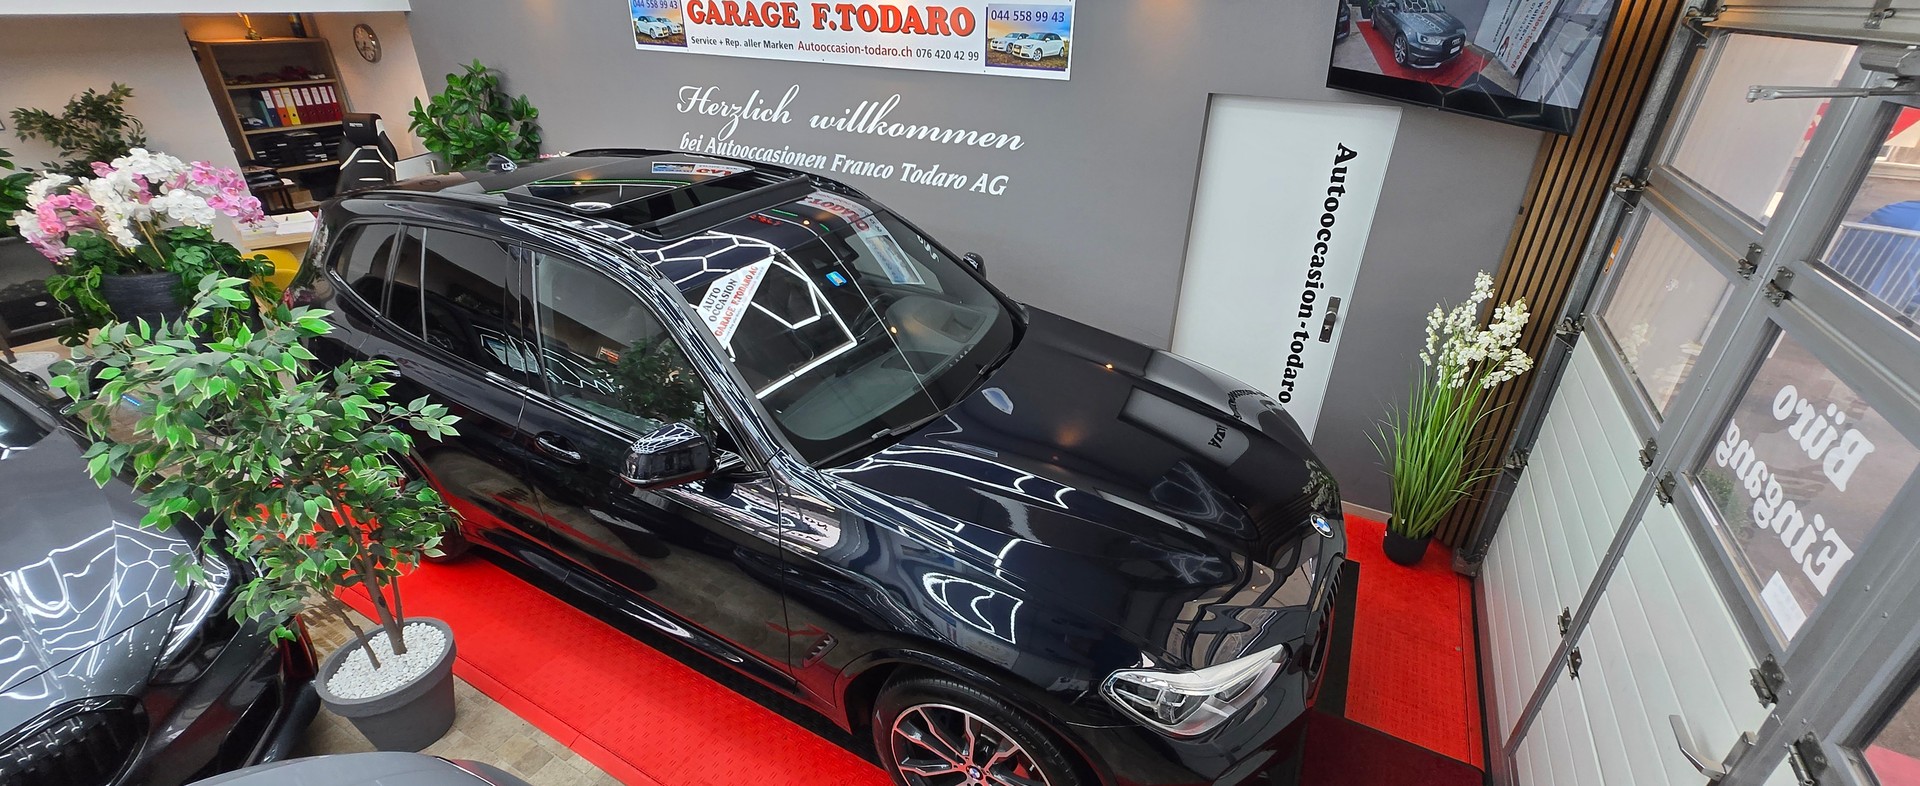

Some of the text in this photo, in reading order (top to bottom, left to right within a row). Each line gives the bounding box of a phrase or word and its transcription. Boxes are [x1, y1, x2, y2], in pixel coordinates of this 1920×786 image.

[632, 0, 678, 9] 044 558 99 43
[686, 0, 976, 36] GARAGE F.TODARO
[991, 10, 1065, 23] 044 558 99 43
[690, 36, 718, 46] Service
[725, 38, 742, 49] Rep.
[743, 40, 761, 48] aller
[763, 41, 794, 51] Marken
[797, 40, 913, 58] Autooccasion-todaro.ch
[916, 48, 932, 59] 076
[934, 49, 951, 60] 420
[953, 51, 965, 61] 42
[968, 52, 979, 62] 99
[676, 84, 1025, 151] Herzlich willkommen
[679, 131, 701, 153] bei
[704, 136, 827, 171] Autooccasionen
[830, 153, 894, 180] Franco
[900, 162, 968, 190] Todaro
[970, 172, 1010, 196] AG
[702, 287, 721, 312] AUTO
[708, 278, 738, 323] OCCASION
[714, 306, 736, 337] GARAGE
